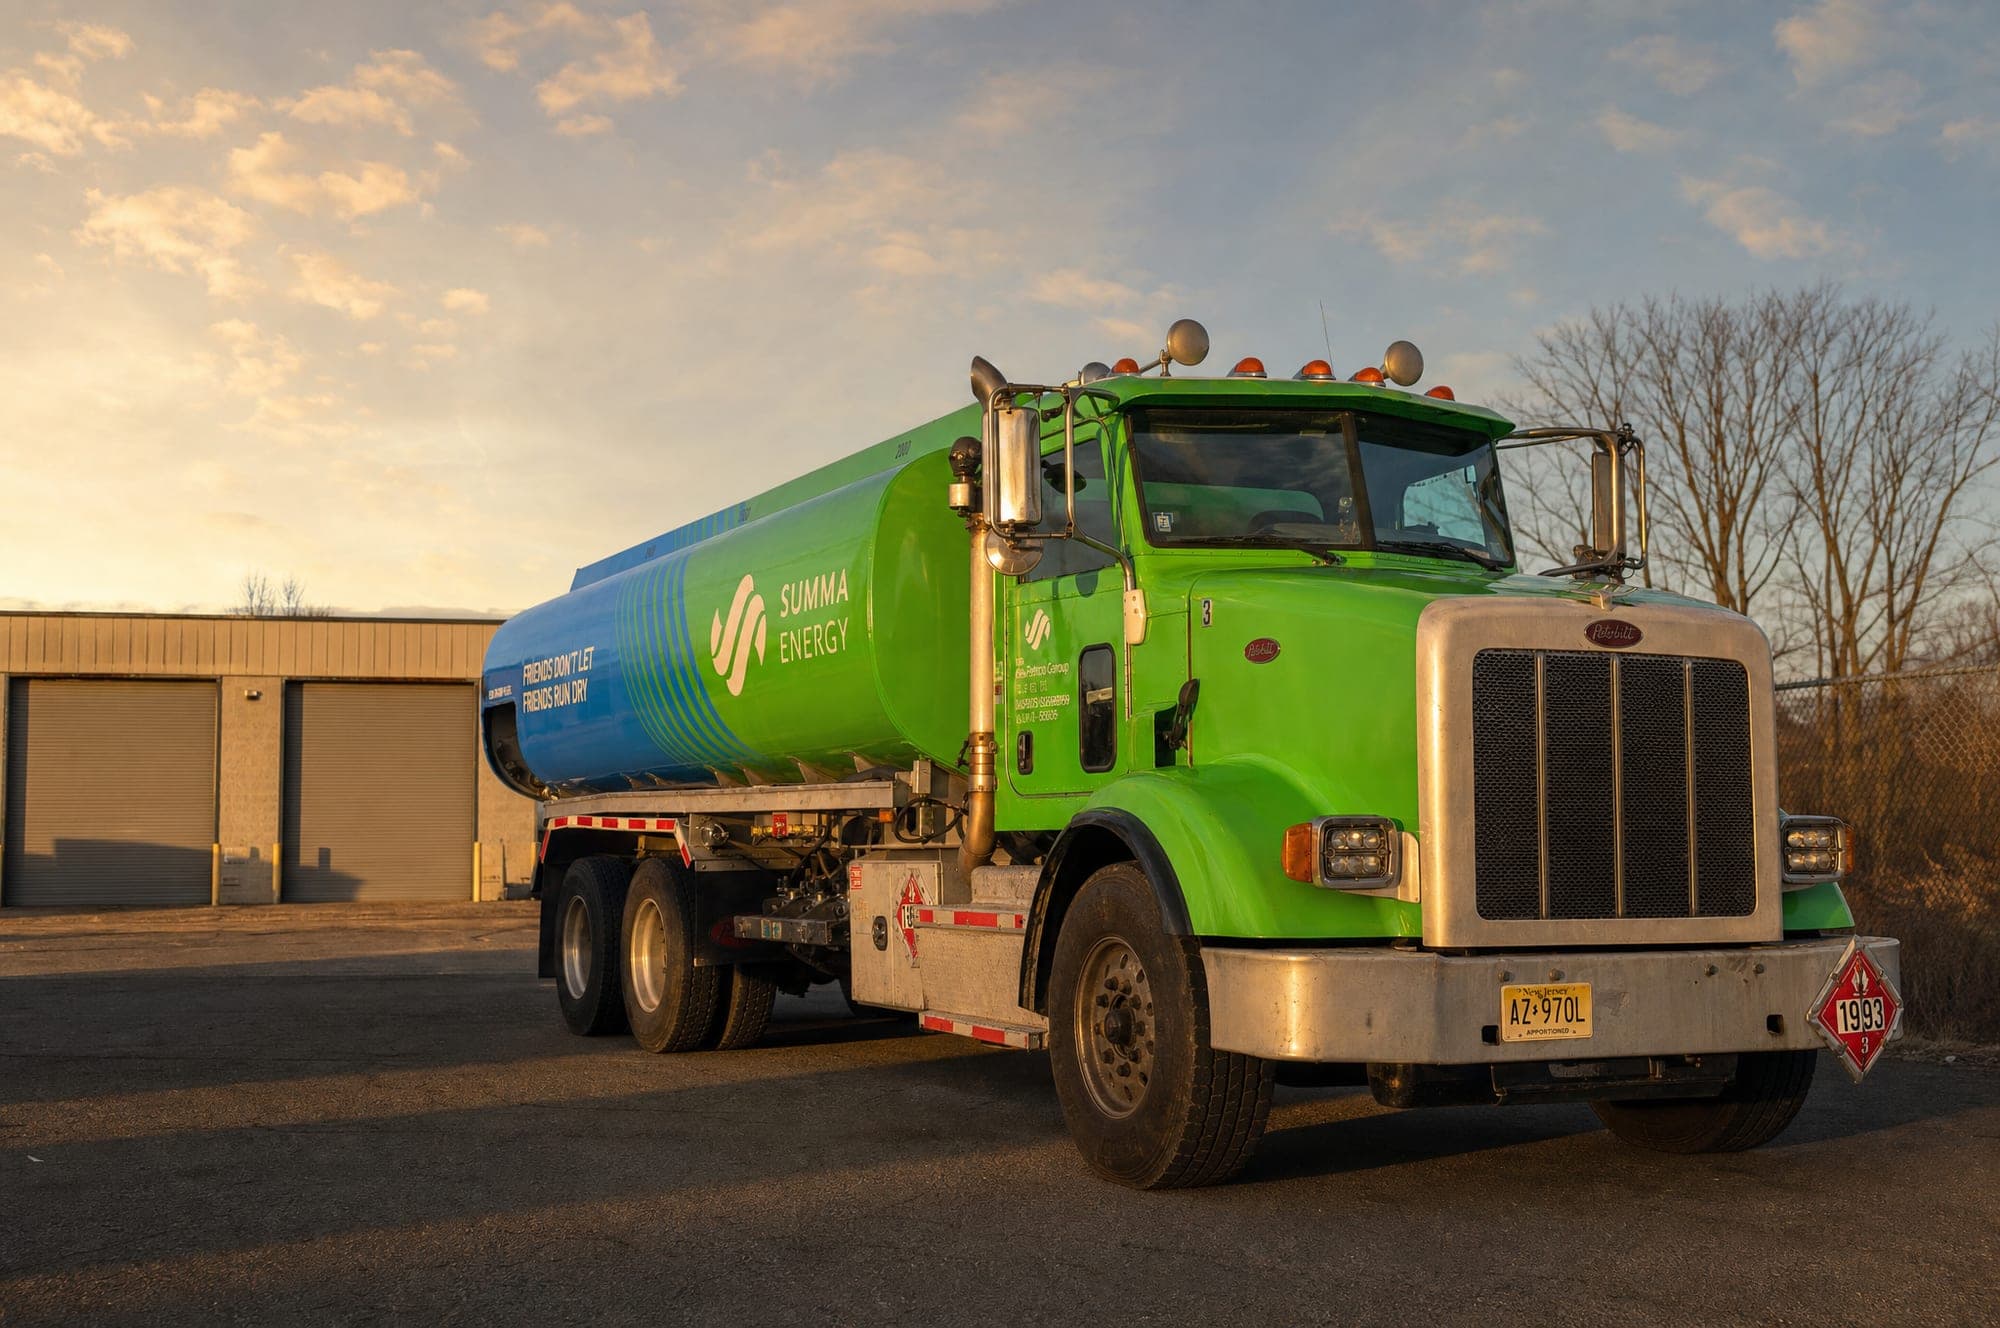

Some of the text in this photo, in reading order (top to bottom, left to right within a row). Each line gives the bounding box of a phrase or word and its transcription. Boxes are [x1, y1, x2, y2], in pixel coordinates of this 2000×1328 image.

[780, 568, 848, 618] SUMMA
[1203, 599, 1211, 626] 3
[780, 617, 848, 664] ENERGY
[522, 645, 594, 687] FRIENDS DON'T LET
[522, 686, 553, 713] FRIENDS
[554, 681, 571, 707] RUN
[572, 678, 588, 704] DRY
[1523, 986, 1568, 998] New Jersey
[1839, 998, 1884, 1032] 1993
[1861, 1036, 1869, 1054] 3
